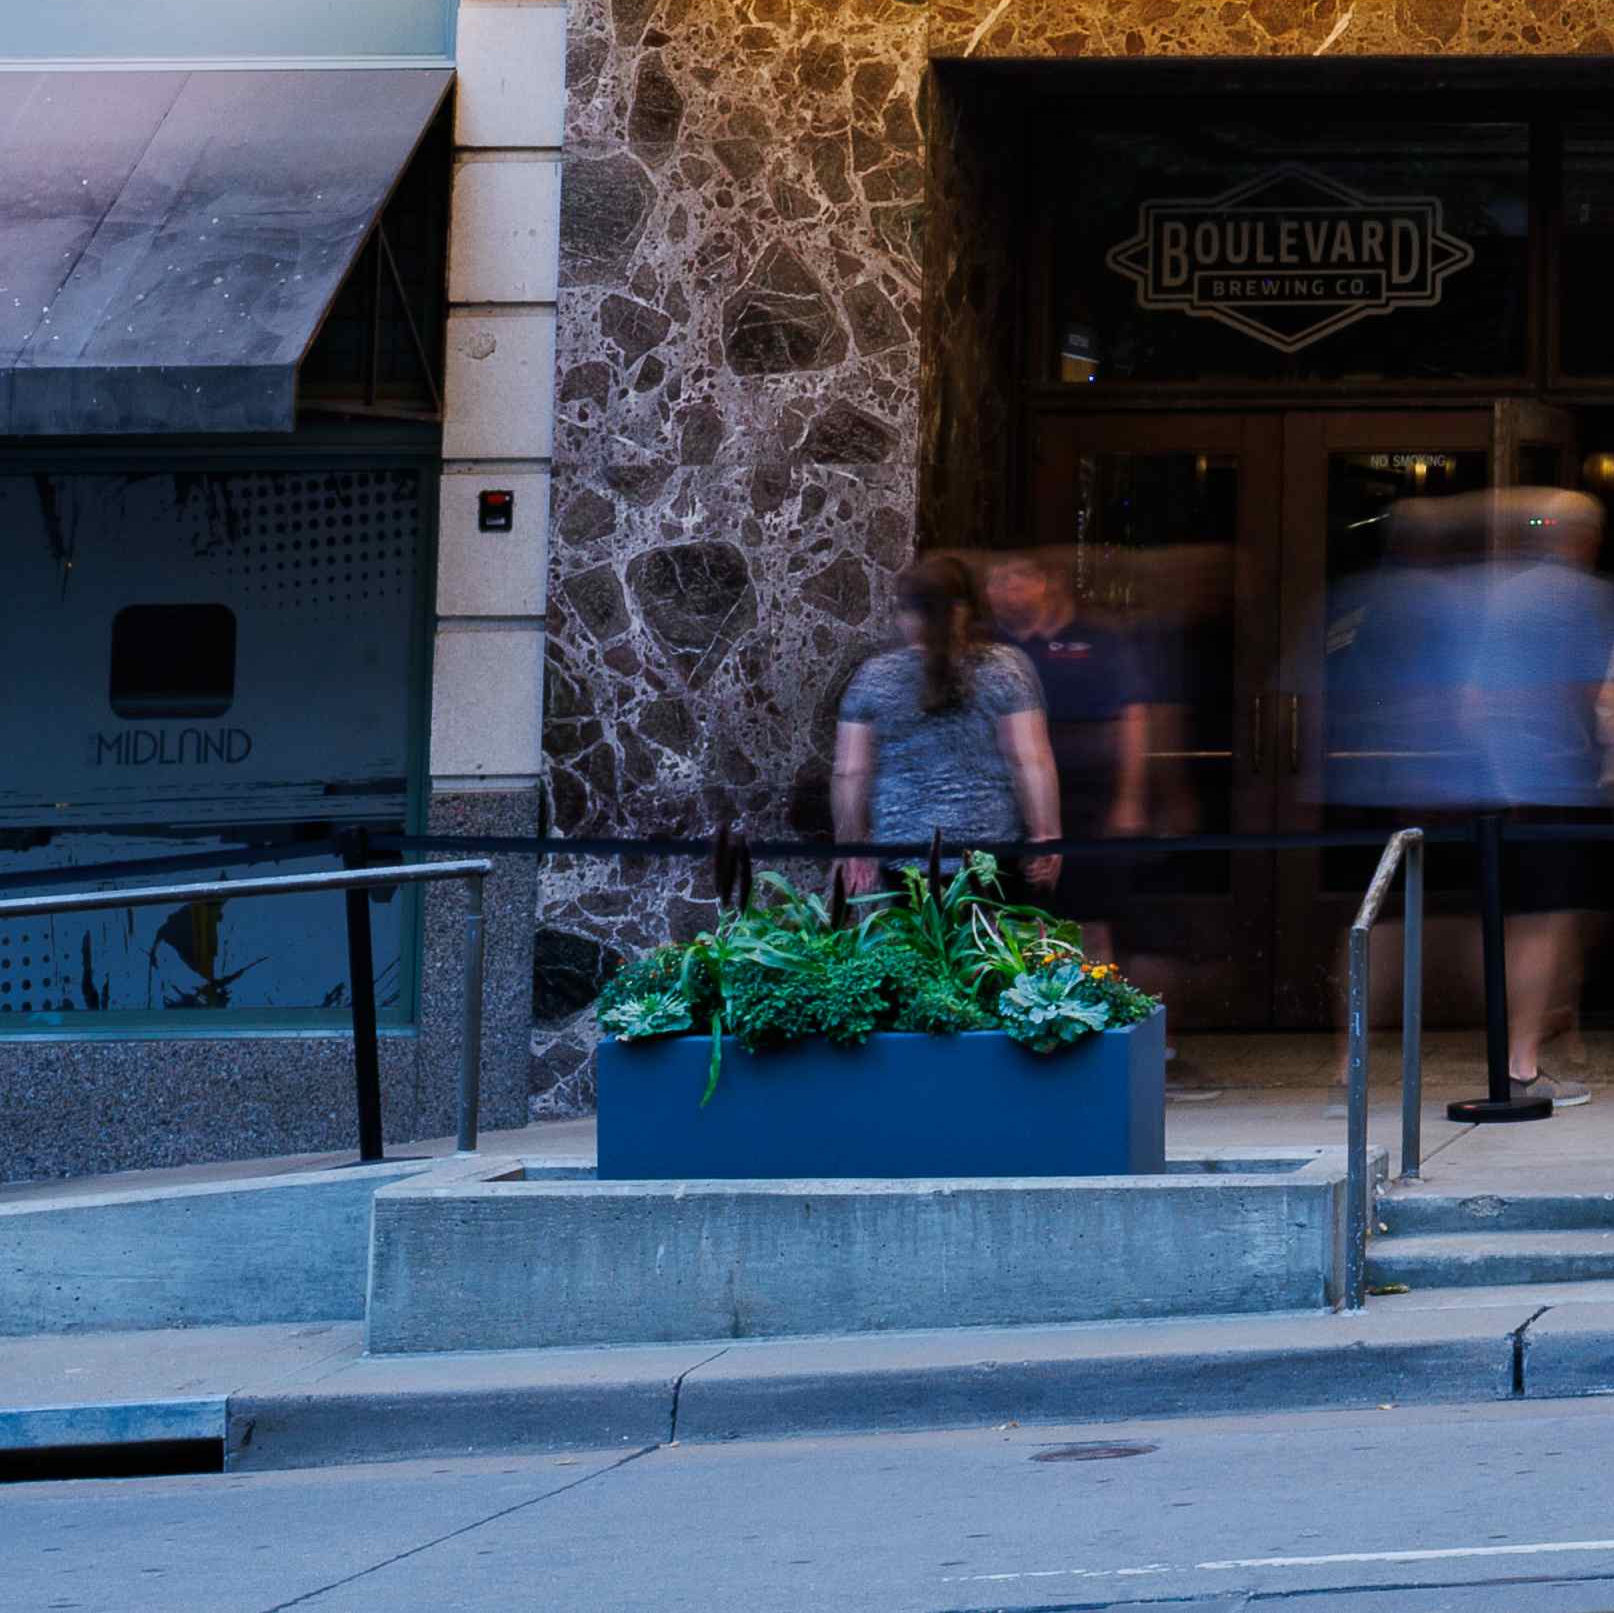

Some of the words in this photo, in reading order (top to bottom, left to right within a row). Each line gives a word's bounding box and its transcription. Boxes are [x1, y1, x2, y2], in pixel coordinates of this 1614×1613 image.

[1161, 218, 1420, 286] BOULEVARD
[1212, 279, 1325, 297] BREWING
[1336, 279, 1373, 297] CO.
[1370, 453, 1390, 467] NO
[96, 728, 252, 766] MIDLAND
